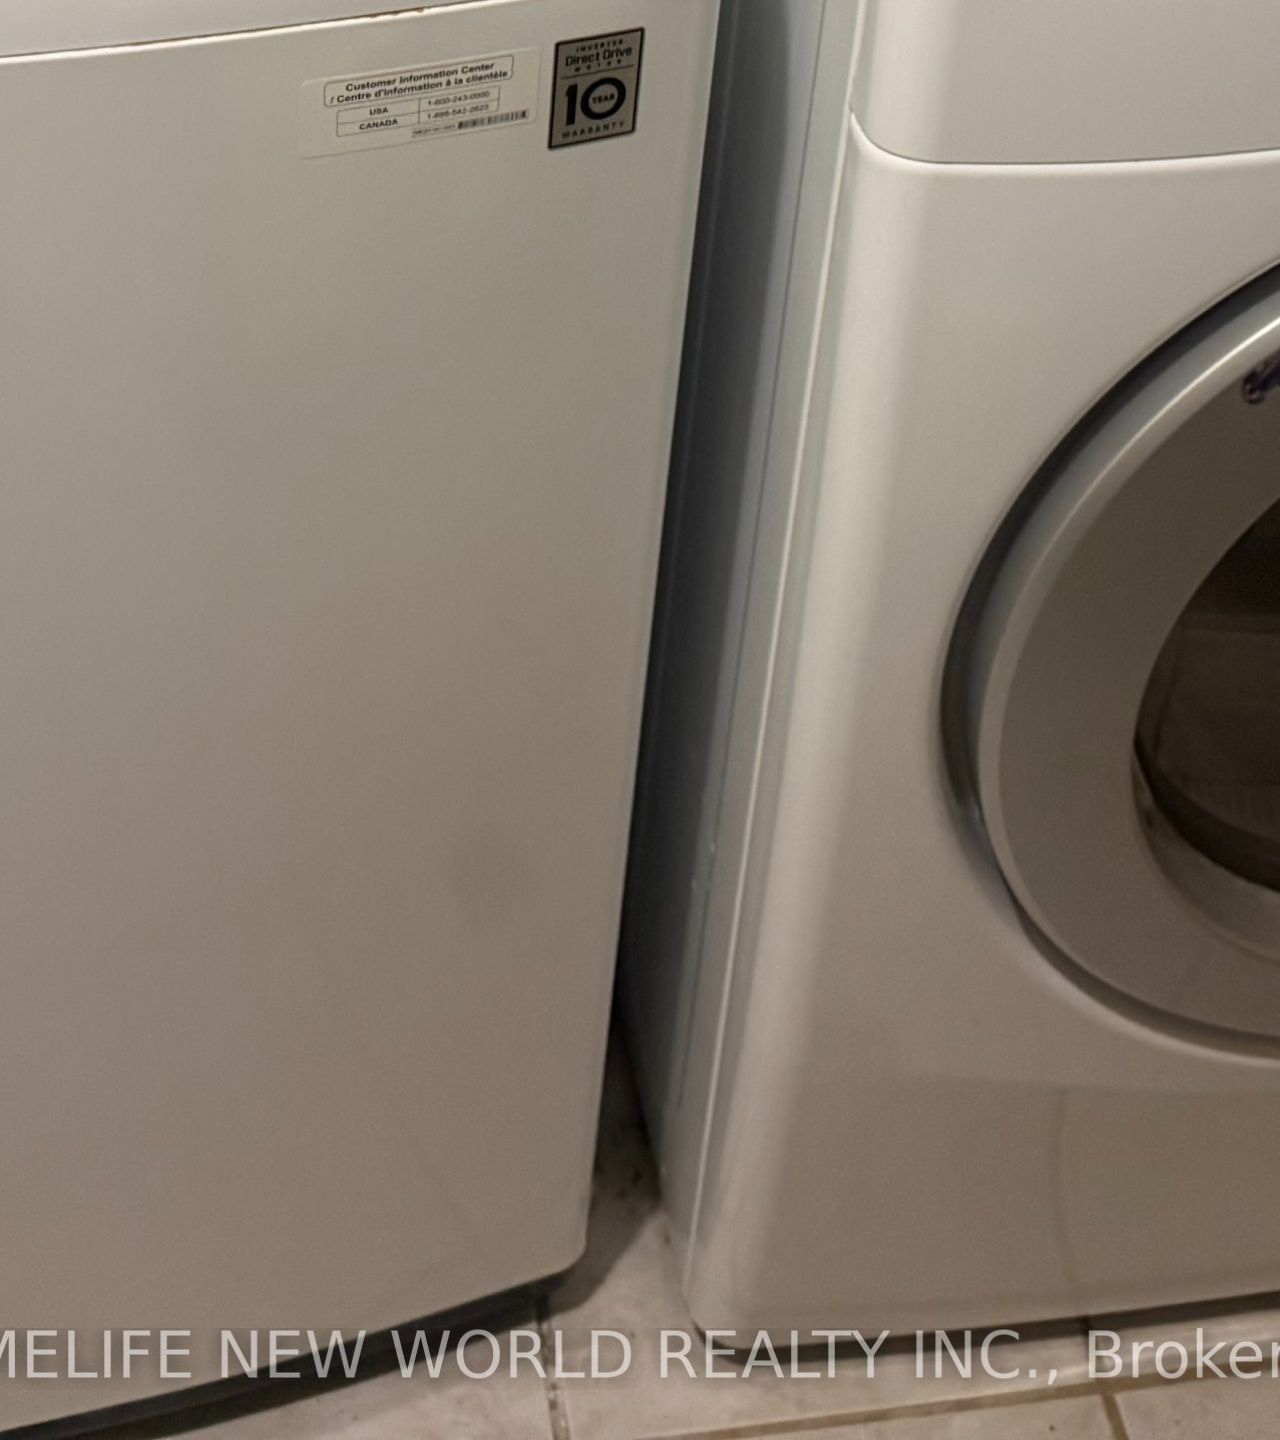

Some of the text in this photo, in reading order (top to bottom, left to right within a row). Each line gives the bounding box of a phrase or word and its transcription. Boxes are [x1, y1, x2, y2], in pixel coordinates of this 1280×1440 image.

[565, 47, 632, 67] Direct Drive
[345, 62, 495, 93] Customer Information Center
[337, 90, 372, 104] Centre
[374, 79, 444, 98] d'information
[454, 76, 464, 86] la
[592, 93, 615, 104] YEAR
[369, 107, 389, 116] USA
[565, 77, 626, 126] 10
[358, 118, 399, 130] CANADA
